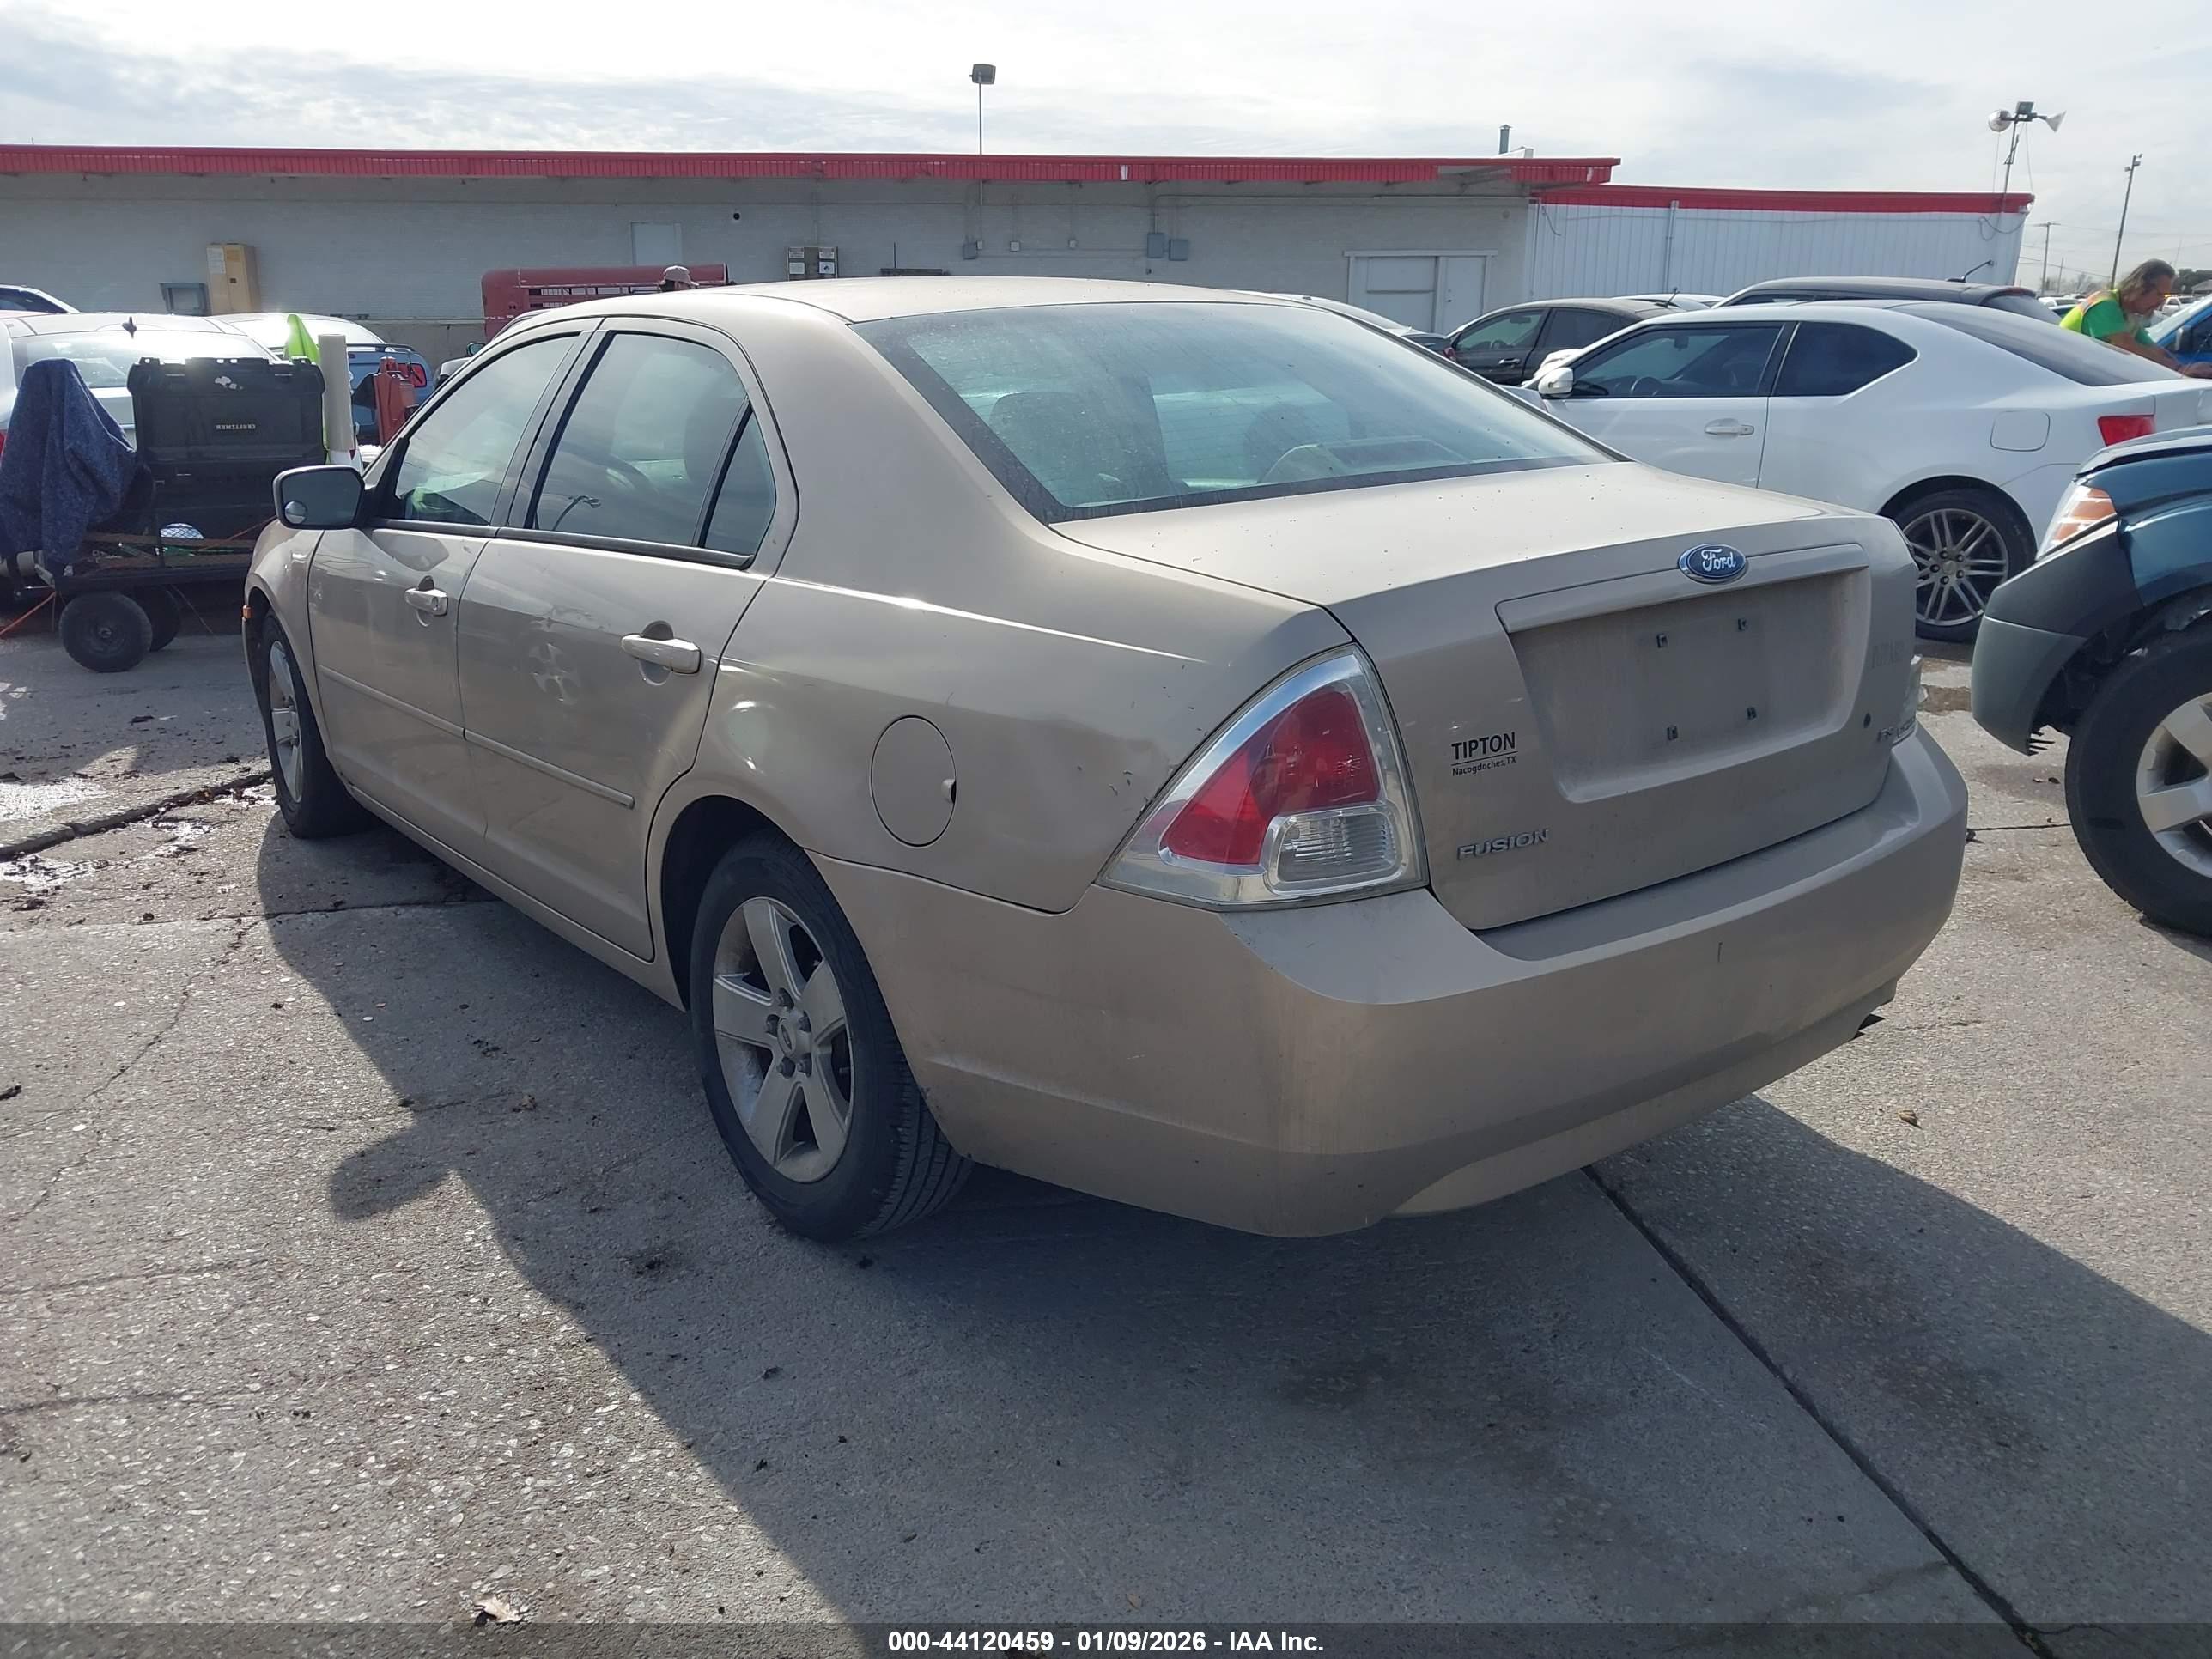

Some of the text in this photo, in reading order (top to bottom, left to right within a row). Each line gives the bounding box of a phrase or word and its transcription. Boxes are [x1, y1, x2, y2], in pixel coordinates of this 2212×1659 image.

[1701, 549, 1736, 572] Ford
[1451, 732, 1516, 760] TIPTON
[1457, 830, 1549, 860] FUSION
